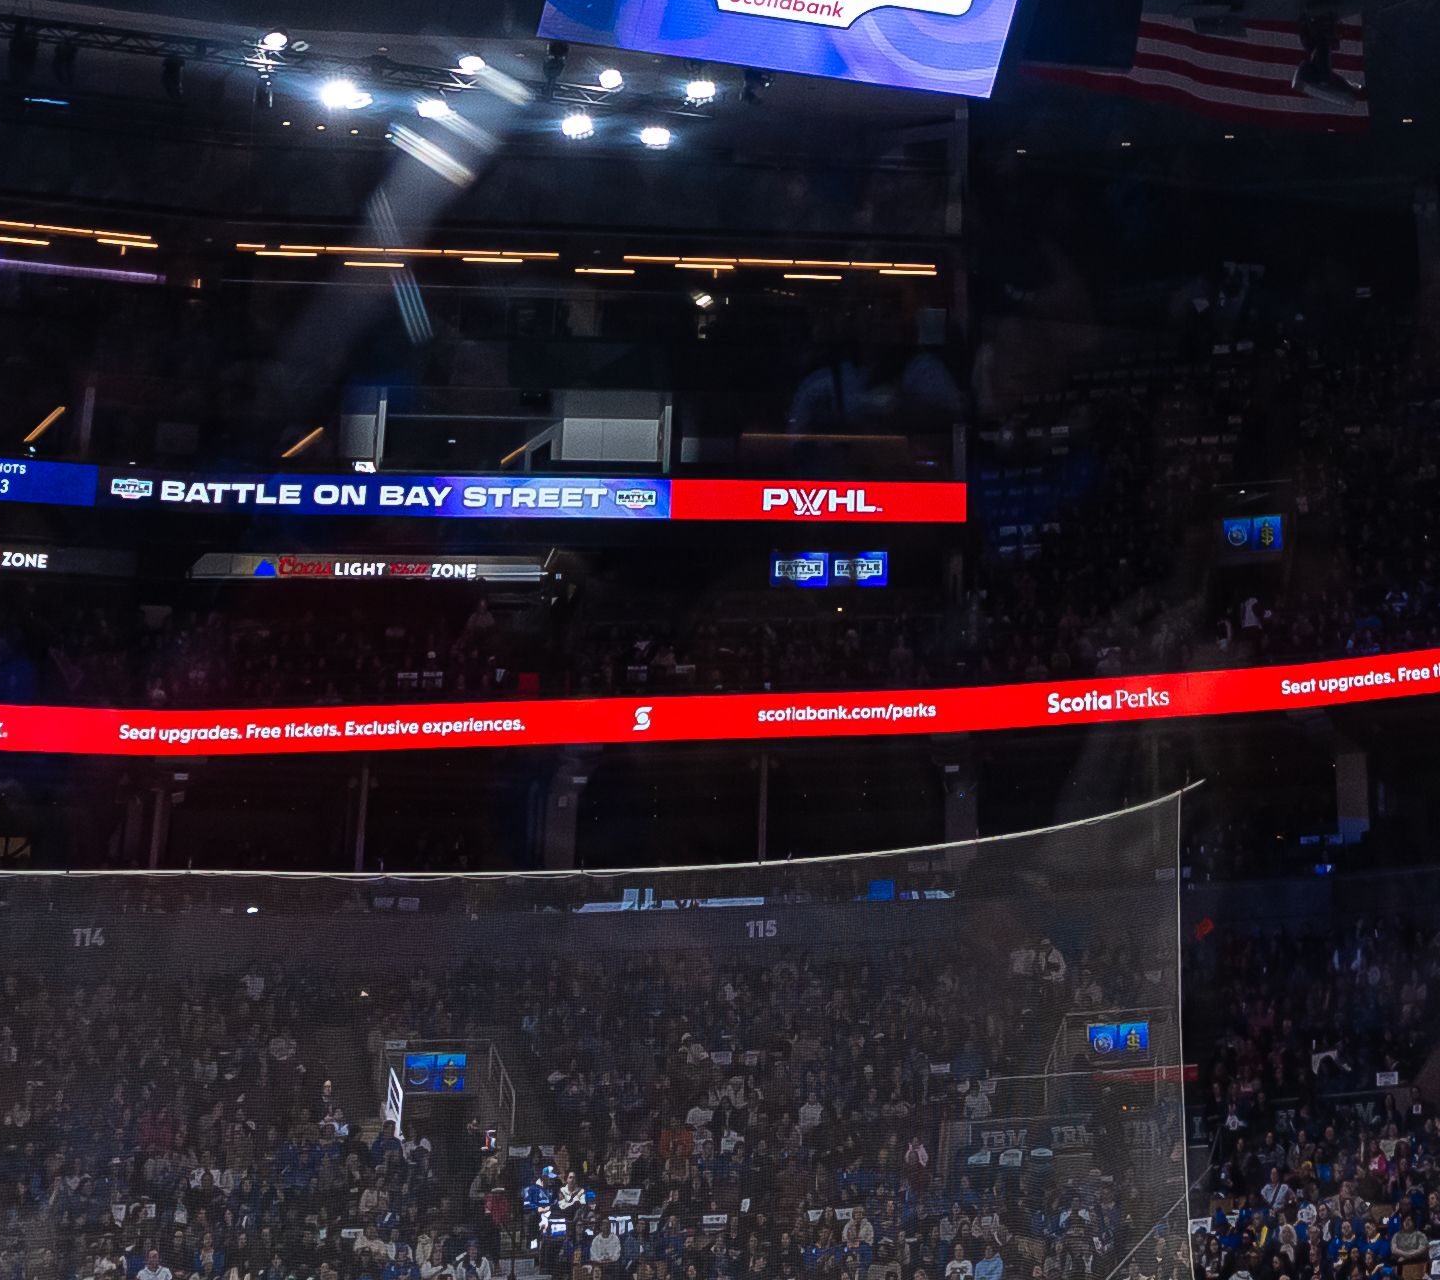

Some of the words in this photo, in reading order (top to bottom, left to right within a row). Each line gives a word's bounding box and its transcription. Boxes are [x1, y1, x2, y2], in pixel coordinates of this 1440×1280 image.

[160, 480, 302, 506] BATTLE
[312, 484, 368, 506] ON
[379, 485, 453, 508] BAY
[462, 486, 608, 510] STREET
[762, 488, 878, 516] PWHL
[0, 551, 50, 570] ZONE
[333, 561, 387, 577] LIGHT
[431, 563, 478, 579] ZONE
[776, 562, 823, 573] BATTLE
[1280, 676, 1317, 698] Seat
[1318, 670, 1396, 696] upgrades.
[1397, 664, 1432, 683] Free
[757, 702, 937, 725] scotiabank.com/perks
[119, 724, 156, 741] Seat
[158, 725, 243, 745] upgrades.
[245, 722, 282, 740] Free
[284, 721, 342, 739] tickets.
[345, 717, 419, 738] Exclusive
[422, 716, 527, 738] experiences.
[71, 928, 106, 947] 114
[745, 919, 778, 939] 115
